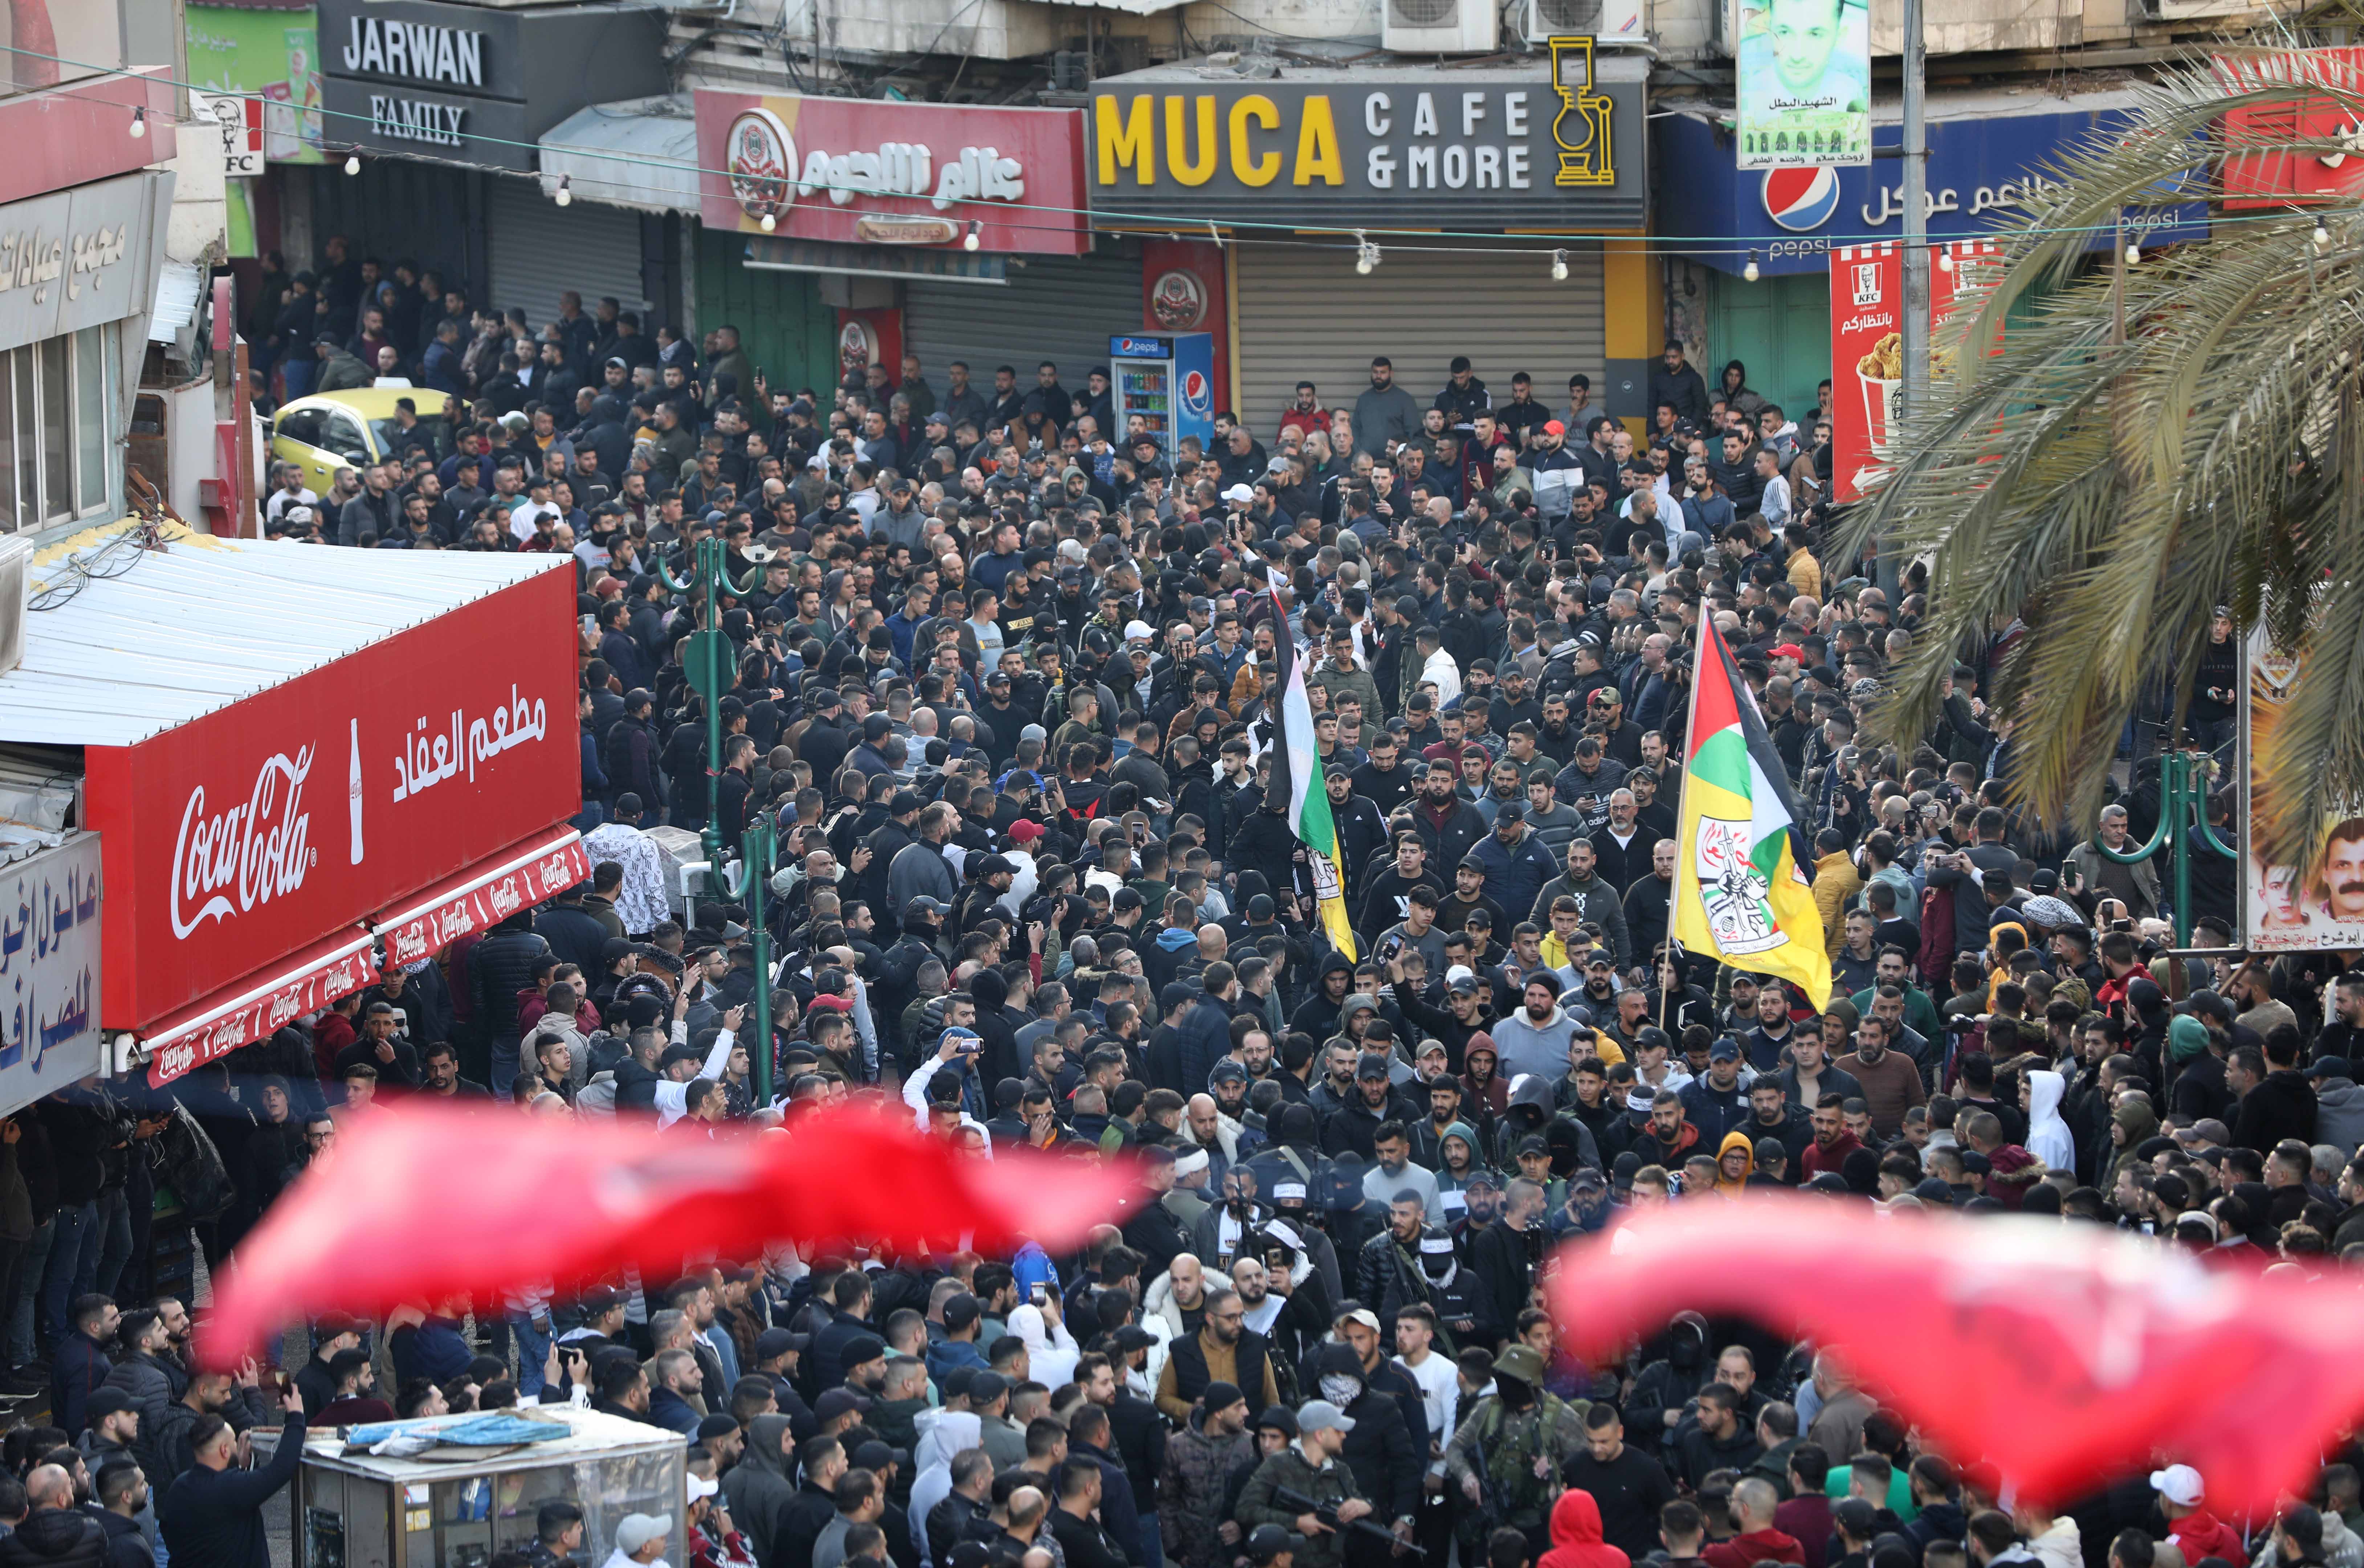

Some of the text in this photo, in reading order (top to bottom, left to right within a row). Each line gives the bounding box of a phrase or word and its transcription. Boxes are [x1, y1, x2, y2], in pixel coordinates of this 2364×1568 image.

[343, 16, 482, 87] JARWAN
[370, 95, 465, 147] FAMILY
[1769, 96, 1837, 111] الشهيد البطل
[1095, 91, 1529, 186] MUCA CAFE
[1816, 154, 1835, 163] سلام
[225, 156, 253, 171] FC
[799, 142, 932, 205] اللحوم
[932, 146, 1024, 211] عالم
[1409, 145, 1531, 188] MORE
[1968, 176, 2075, 215] طاعم
[68, 222, 125, 301] مجمع
[1770, 235, 1831, 260] pepsi
[1858, 293, 1877, 303] KFC
[1842, 311, 1892, 335] بانتظاركم
[1134, 342, 1158, 352] pepsi
[1680, 659, 1693, 670] NIK
[394, 683, 546, 803] مطعم العقاد
[170, 739, 316, 940] Coca-Cola
[0, 876, 36, 975] إخو
[2345, 929, 2360, 946] أبو
[0, 964, 90, 1075] للصراف
